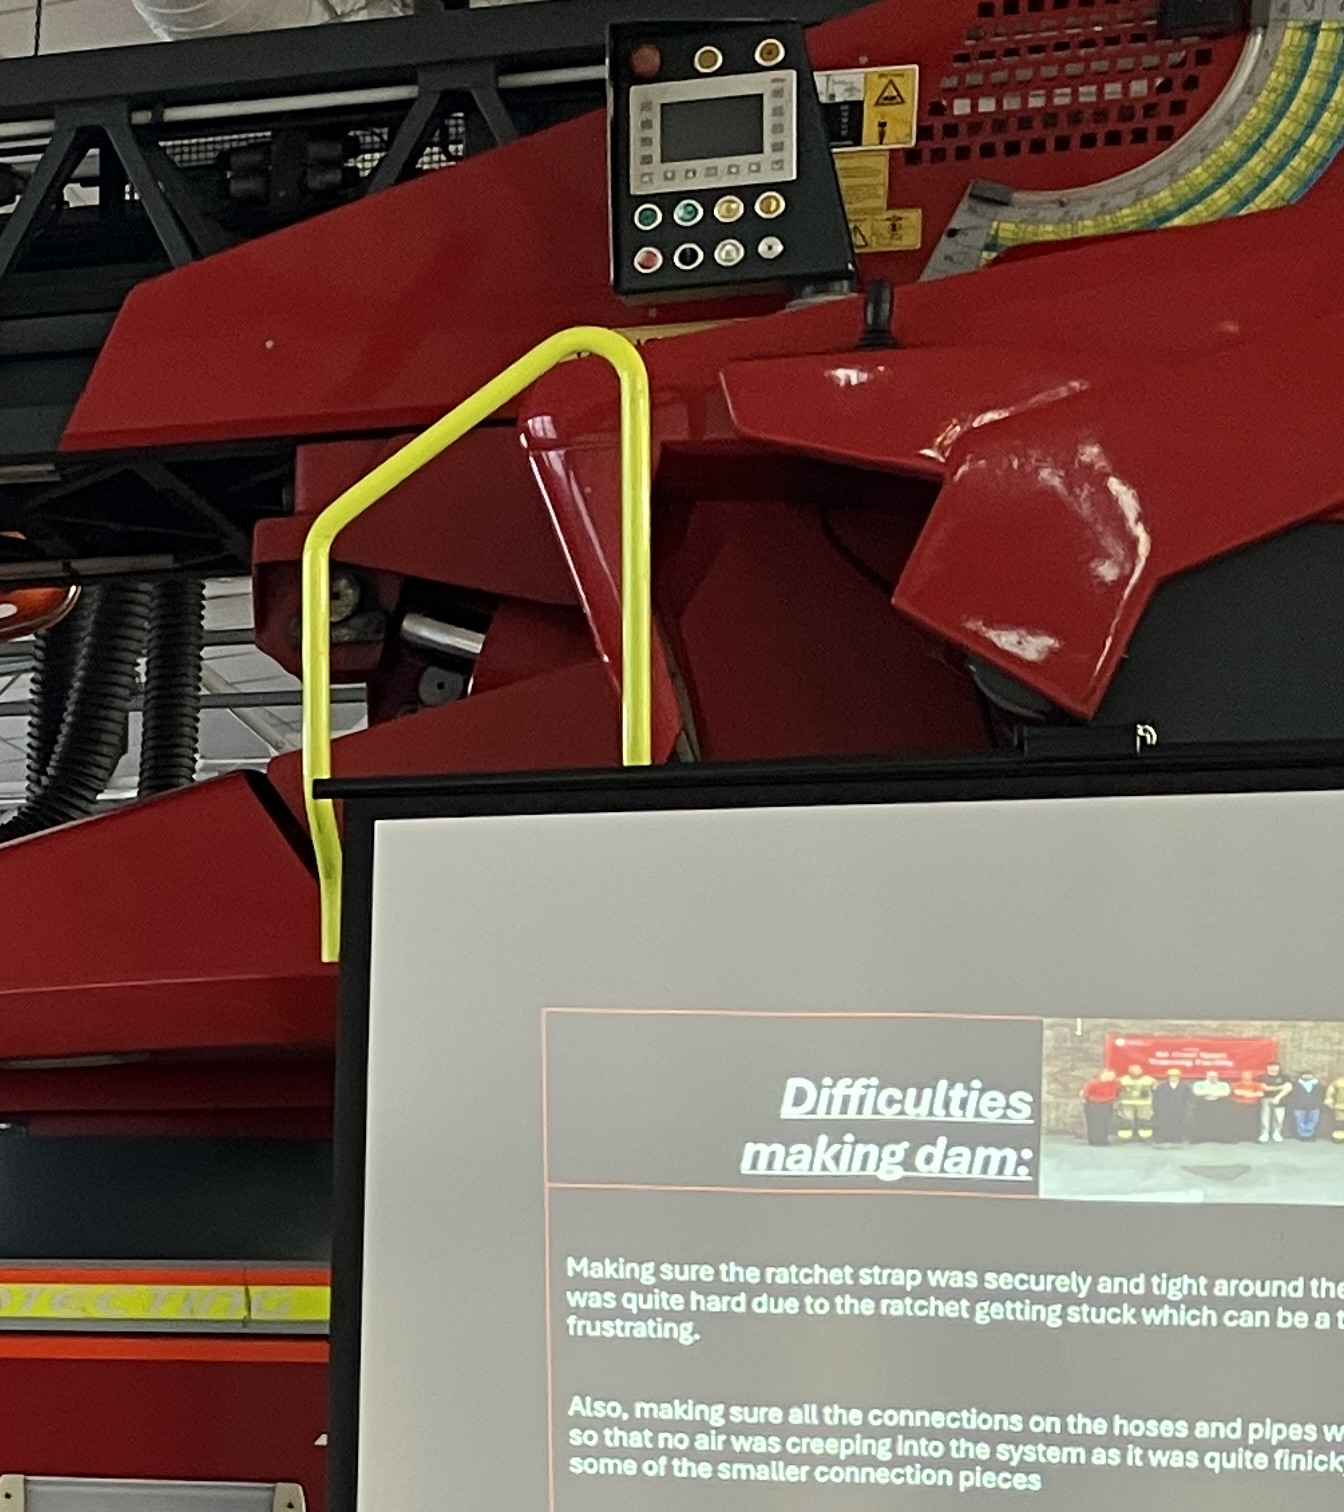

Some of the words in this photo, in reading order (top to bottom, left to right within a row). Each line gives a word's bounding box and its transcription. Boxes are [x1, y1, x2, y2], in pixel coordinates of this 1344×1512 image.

[780, 1076, 1034, 1122] Difficulties
[741, 1133, 910, 1181] making
[914, 1135, 1033, 1179] dam:
[566, 1256, 656, 1285] Making
[659, 1262, 714, 1281] sure
[719, 1262, 760, 1284] the
[765, 1263, 854, 1285] ratchet
[859, 1265, 922, 1291] strap
[927, 1269, 978, 1288] was
[984, 1271, 1092, 1298] securely
[1097, 1273, 1145, 1295] and
[1151, 1273, 1208, 1301] tight
[1213, 1276, 1304, 1298] around
[566, 1290, 617, 1309] was
[621, 1288, 684, 1314] quite
[690, 1290, 746, 1313] hard
[752, 1292, 800, 1314] due
[804, 1294, 829, 1315] to
[835, 1294, 875, 1316] the
[880, 1296, 971, 1318] ratchet
[975, 1299, 1063, 1328] getting
[1067, 1303, 1136, 1325] stuck
[1141, 1303, 1218, 1327] which
[1223, 1309, 1270, 1328] can
[1276, 1306, 1309, 1329] be
[1314, 1311, 1331, 1330] a
[566, 1315, 701, 1345] frustrating.
[568, 1395, 629, 1421] Also,
[634, 1399, 726, 1427] making
[729, 1405, 782, 1424] sure
[788, 1404, 819, 1424] all
[823, 1404, 863, 1425] the
[868, 1408, 1024, 1432] connections
[1029, 1415, 1061, 1433] on
[1067, 1413, 1108, 1435] the
[1113, 1414, 1189, 1438] hoses
[1194, 1417, 1242, 1439] and
[1248, 1418, 1318, 1445] pipes
[568, 1427, 598, 1447] so
[603, 1426, 653, 1448] that
[658, 1432, 689, 1450] no
[694, 1430, 727, 1451] air
[731, 1435, 781, 1454] was
[786, 1433, 893, 1461] creeping
[897, 1435, 945, 1457] into
[949, 1438, 991, 1459] the
[996, 1441, 1086, 1467] system
[1091, 1447, 1121, 1466] as
[1126, 1444, 1143, 1467] it
[1148, 1449, 1199, 1468] was
[1204, 1447, 1269, 1474] quite
[569, 1455, 638, 1476] some
[642, 1455, 668, 1477] of
[672, 1457, 713, 1479] the
[717, 1460, 811, 1482] smaller
[814, 1463, 953, 1485] connection
[959, 1466, 1042, 1492] pieces
